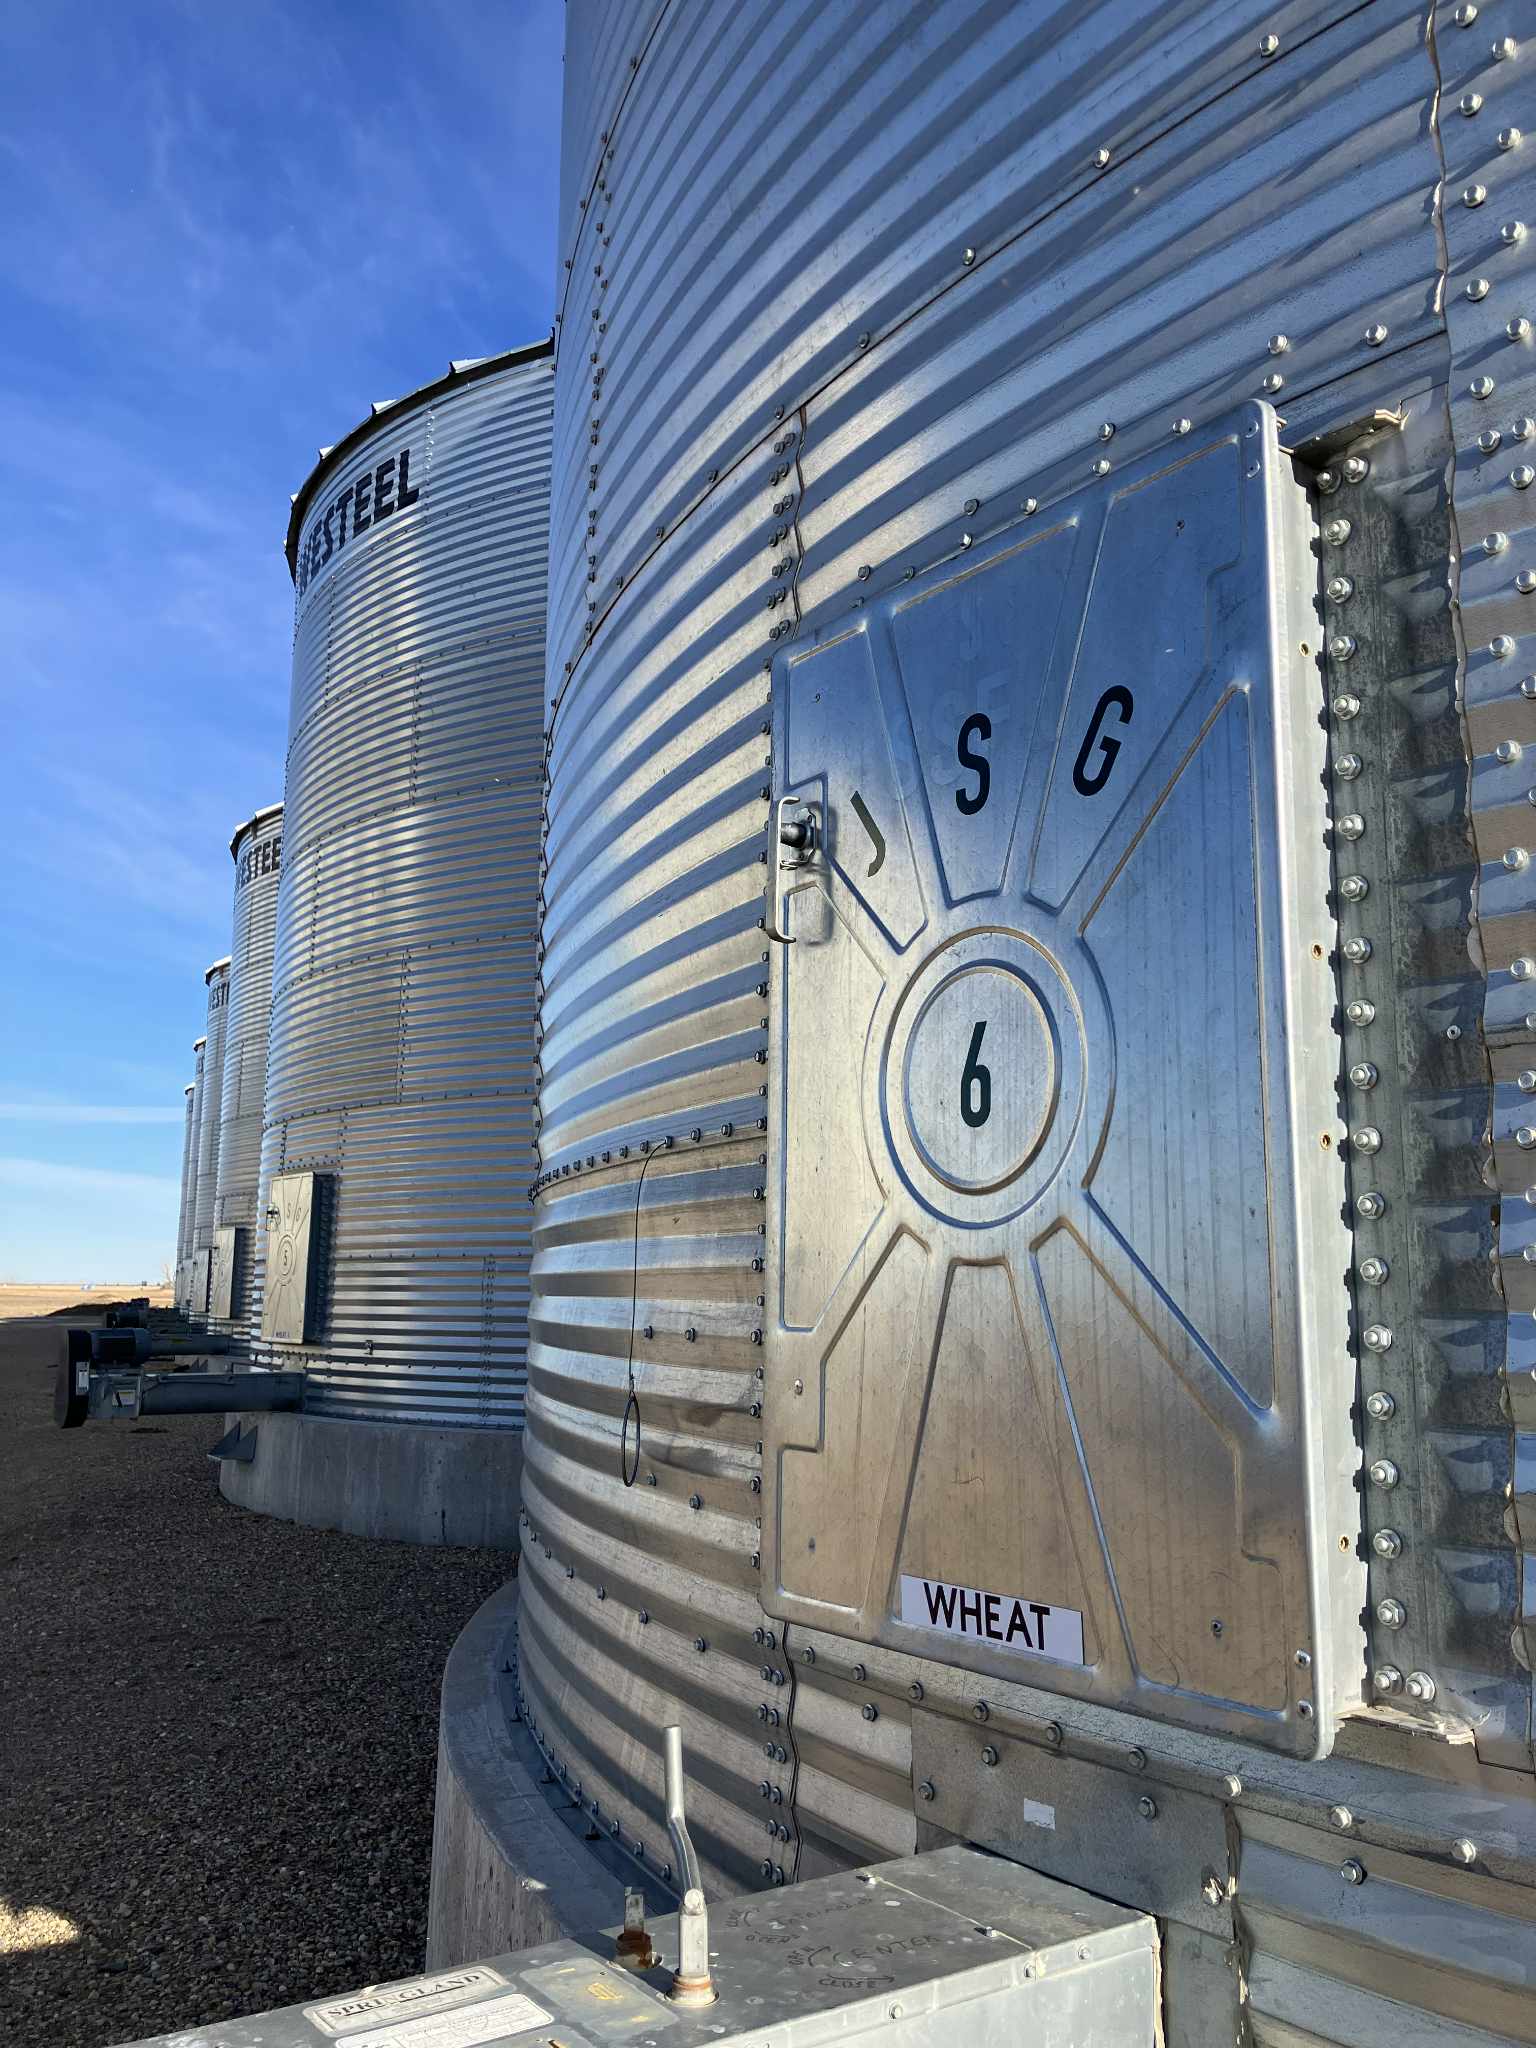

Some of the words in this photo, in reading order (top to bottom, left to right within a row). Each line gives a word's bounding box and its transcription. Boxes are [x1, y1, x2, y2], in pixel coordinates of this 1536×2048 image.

[850, 790, 886, 877] J
[955, 712, 992, 816] S
[1072, 684, 1136, 796] G
[959, 1020, 992, 1128] 6
[923, 1582, 1051, 1651] WHEAT
[328, 1974, 480, 2017] SPRINGLAND
